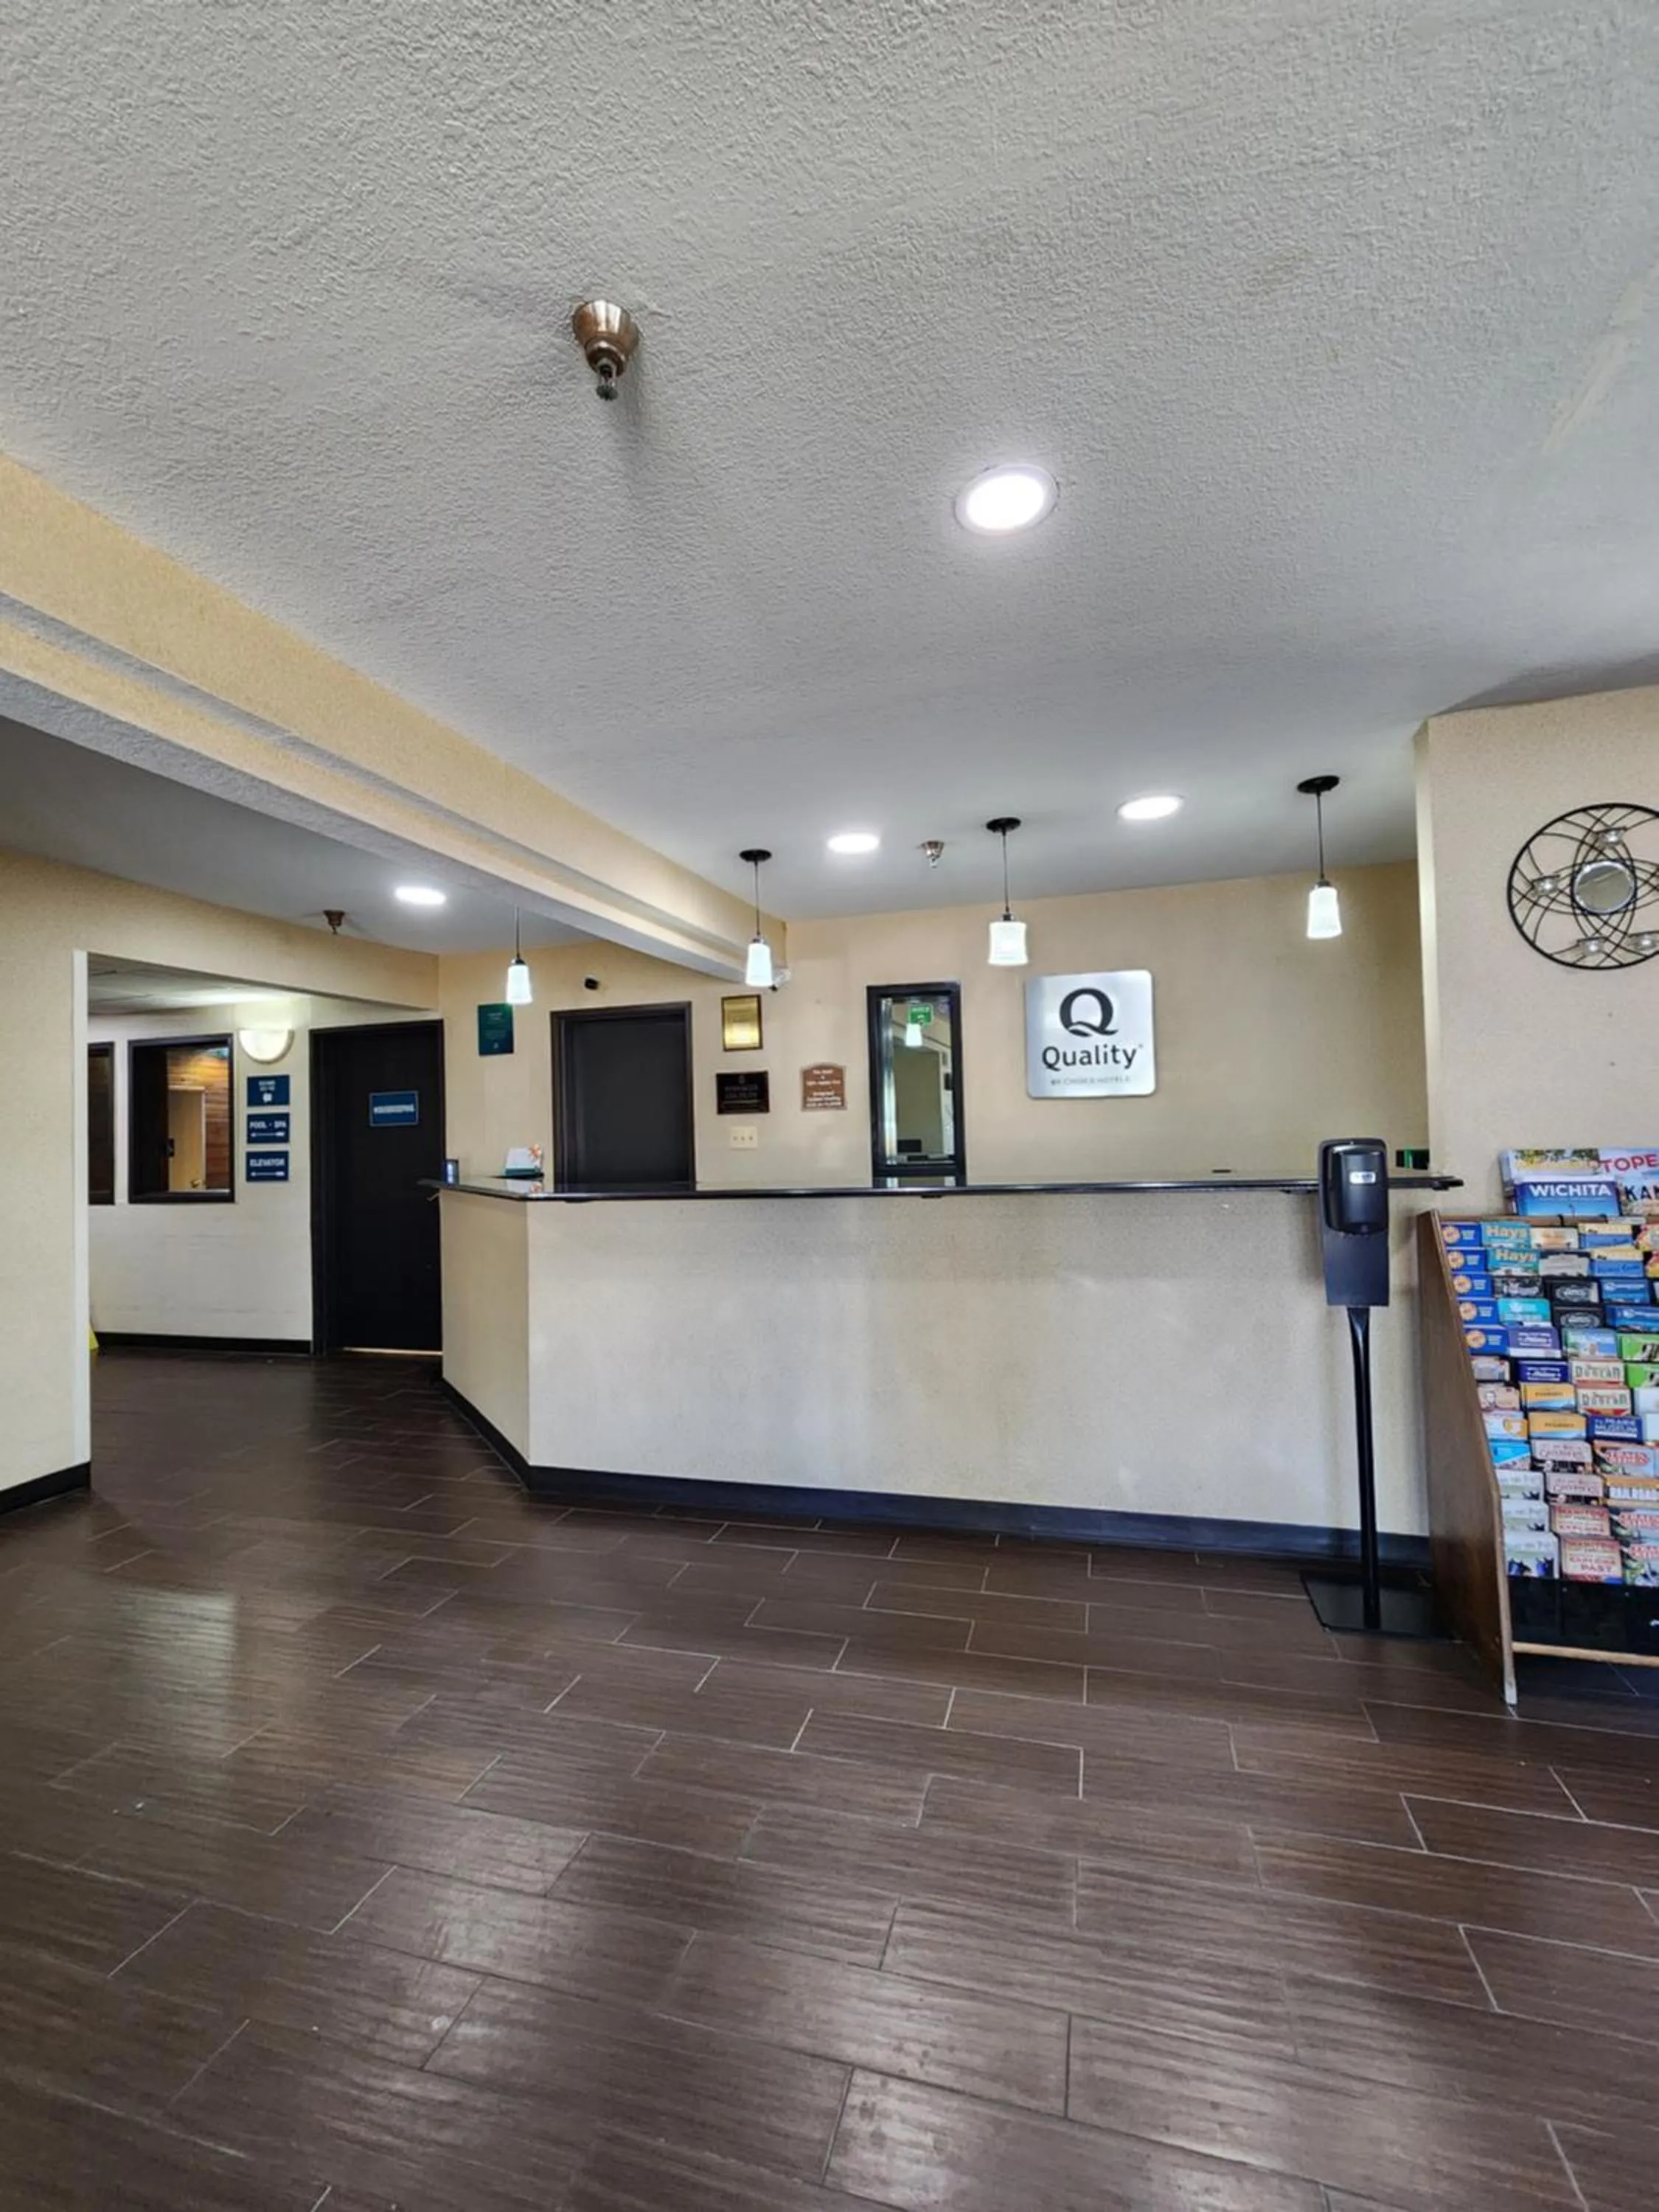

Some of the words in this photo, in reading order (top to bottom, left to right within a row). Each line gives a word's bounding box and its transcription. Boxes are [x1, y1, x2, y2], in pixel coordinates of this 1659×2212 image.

[1059, 987, 1119, 1037] Q
[1041, 1043, 1137, 1071] Quality
[249, 1158, 285, 1166] ELEVATOR
[1528, 1183, 1611, 1197] WICHITA
